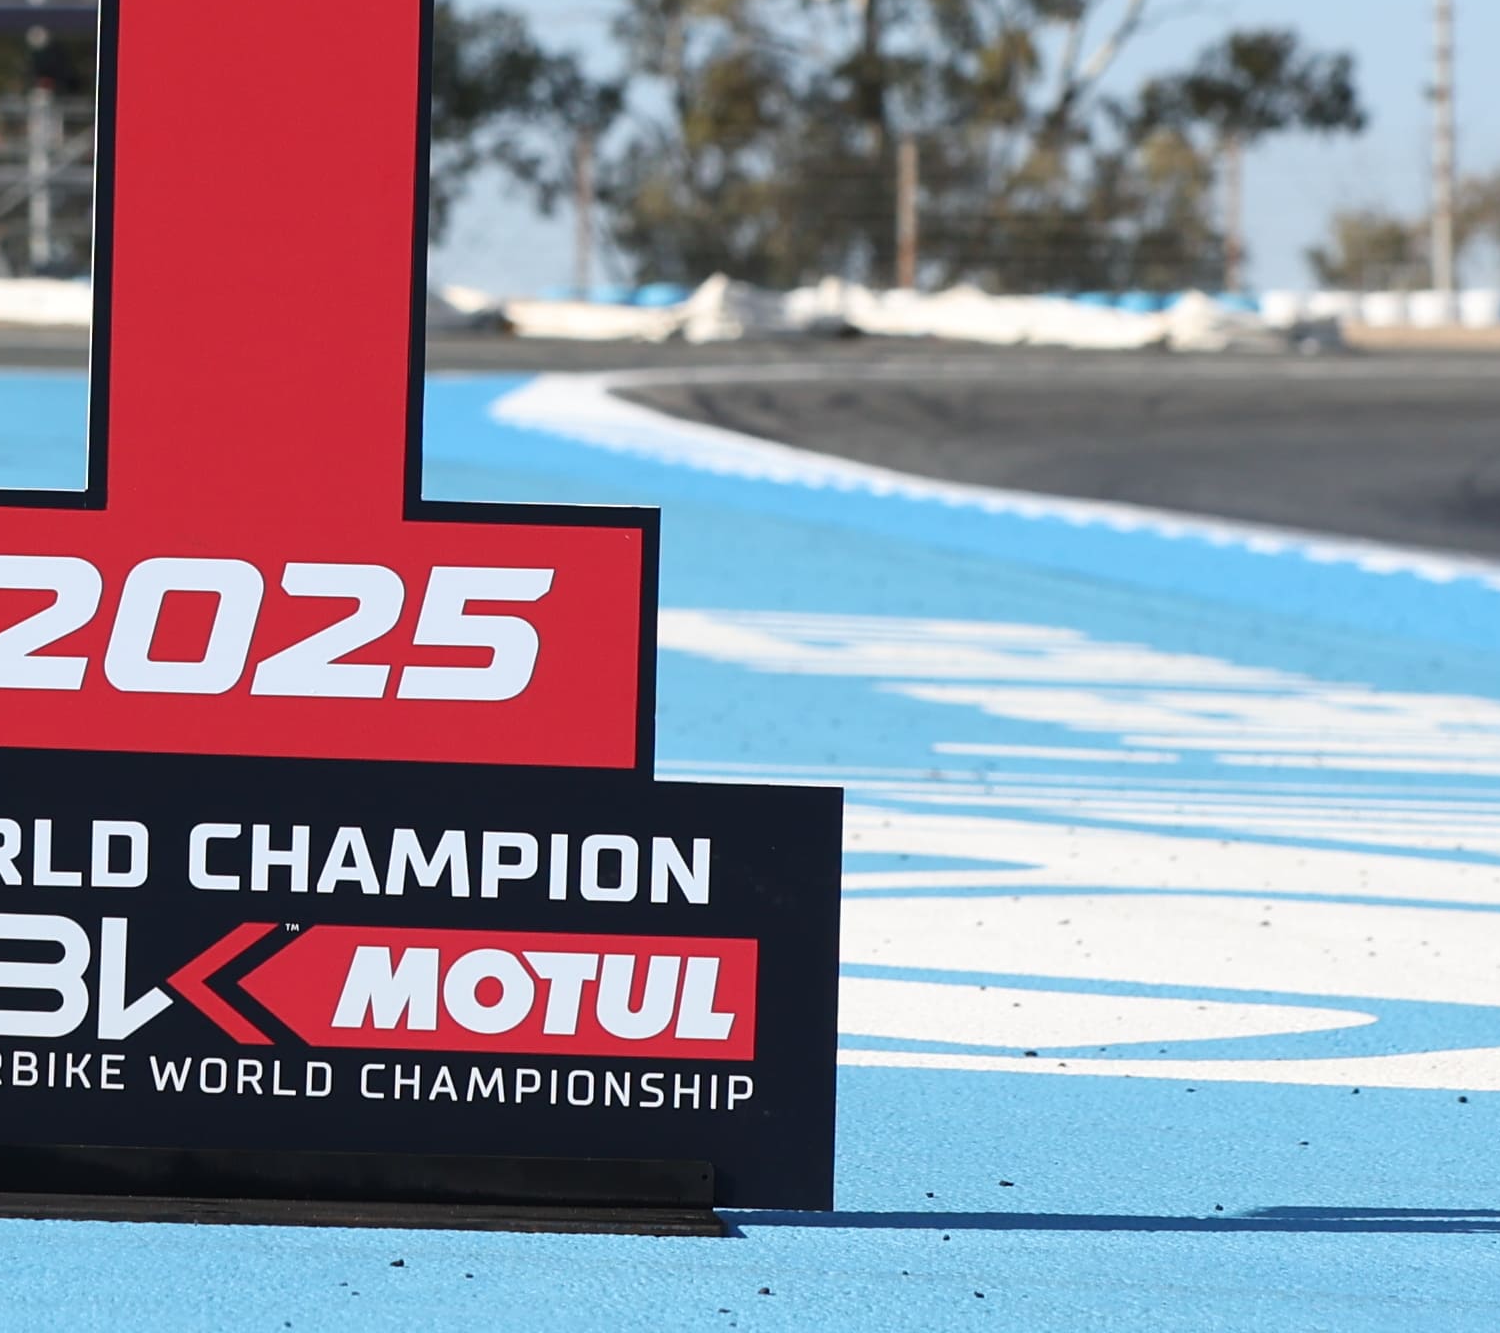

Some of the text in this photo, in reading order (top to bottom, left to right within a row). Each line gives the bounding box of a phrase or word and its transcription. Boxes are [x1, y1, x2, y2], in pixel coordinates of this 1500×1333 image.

[188, 822, 711, 905] CHAMPION
[331, 945, 735, 1041] MOTUL
[149, 1055, 332, 1099] WORLD
[360, 1063, 755, 1111] CHAMPIONSHIP
